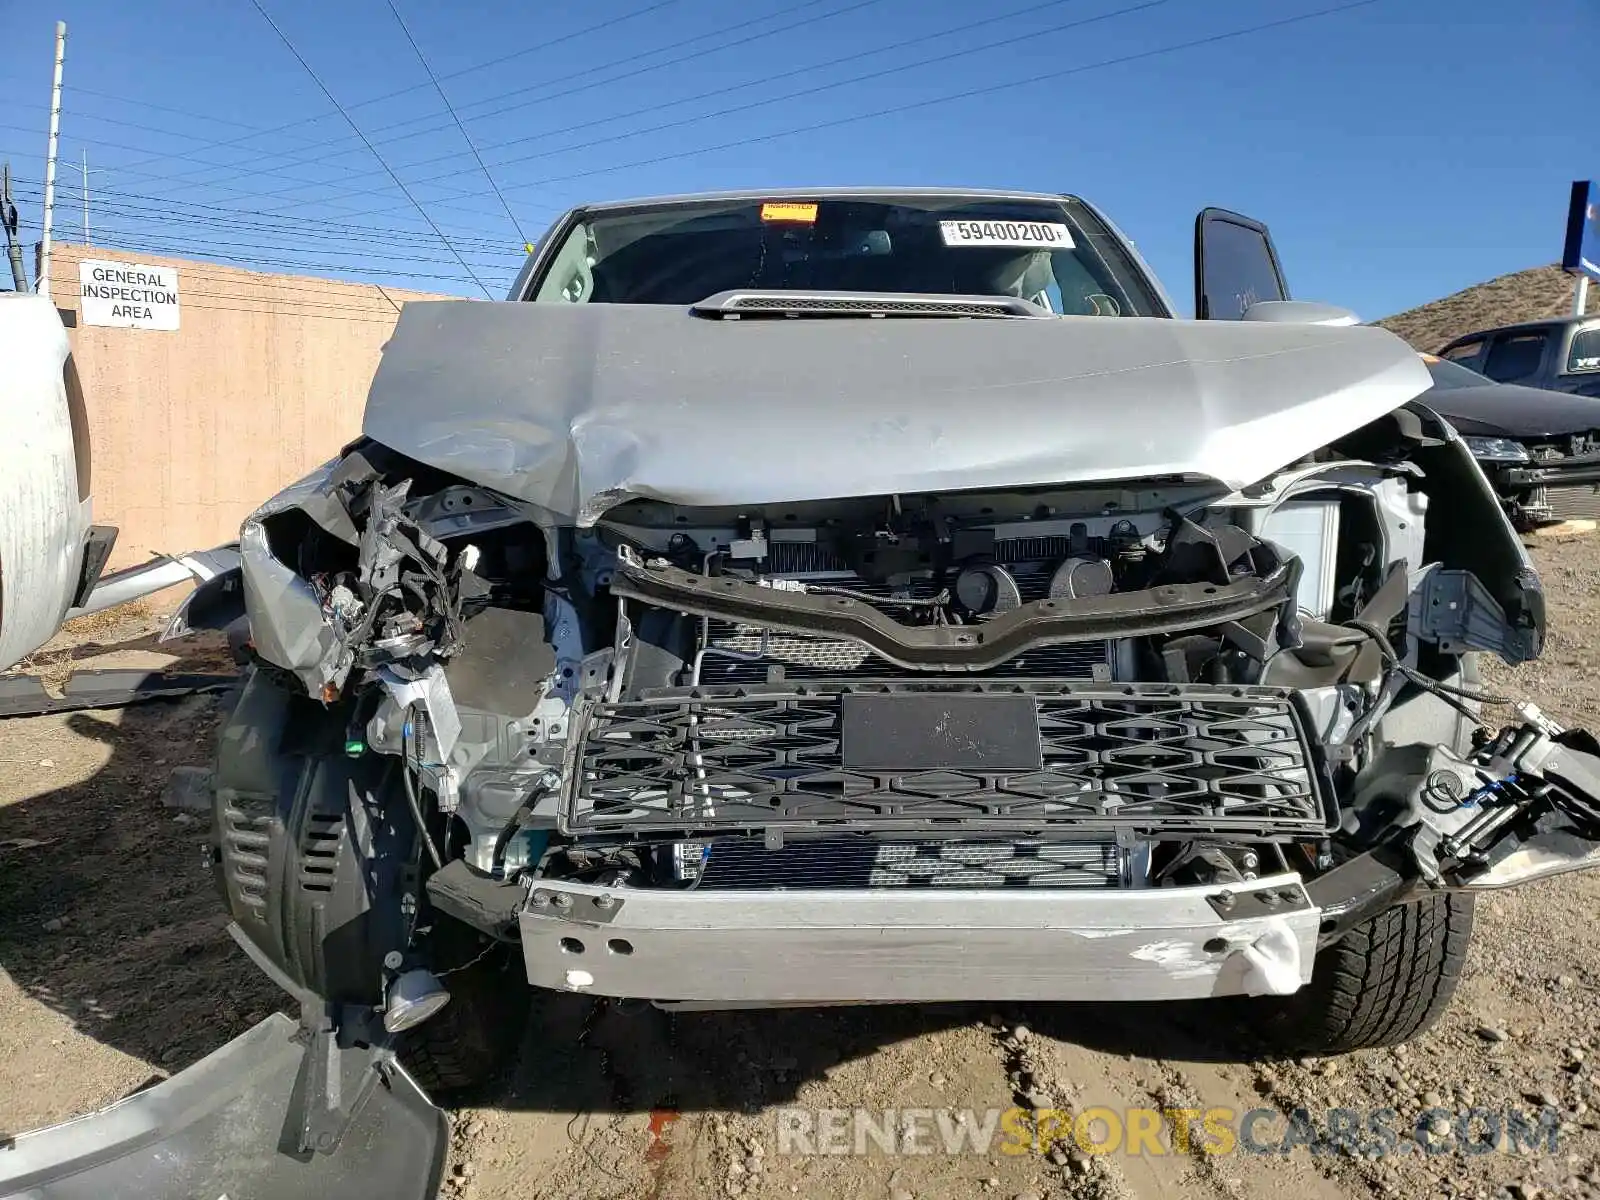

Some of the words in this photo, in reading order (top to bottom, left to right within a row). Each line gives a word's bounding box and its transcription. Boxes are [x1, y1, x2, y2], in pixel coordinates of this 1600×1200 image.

[957, 222, 1056, 242] 59400200
[92, 268, 166, 286] GENERAL
[83, 284, 176, 304] INSPECTION
[111, 304, 153, 319] AREA
